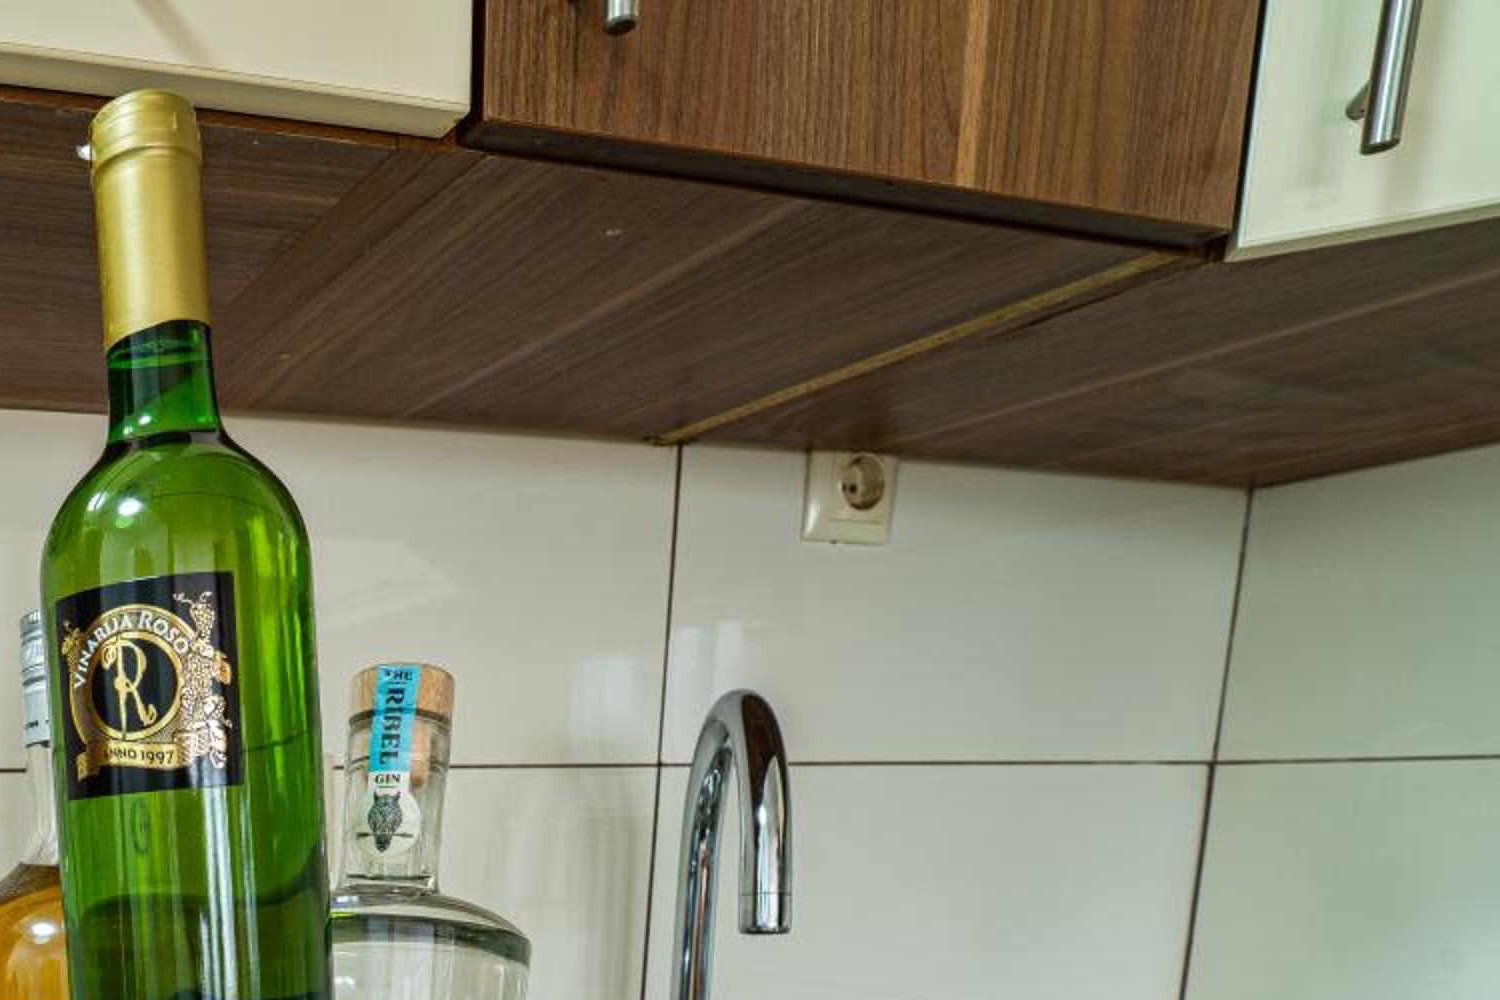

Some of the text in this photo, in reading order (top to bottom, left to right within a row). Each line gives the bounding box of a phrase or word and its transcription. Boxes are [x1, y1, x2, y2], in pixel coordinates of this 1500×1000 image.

[101, 634, 158, 741] R
[141, 748, 175, 765] 1997
[374, 773, 402, 785] GIN
